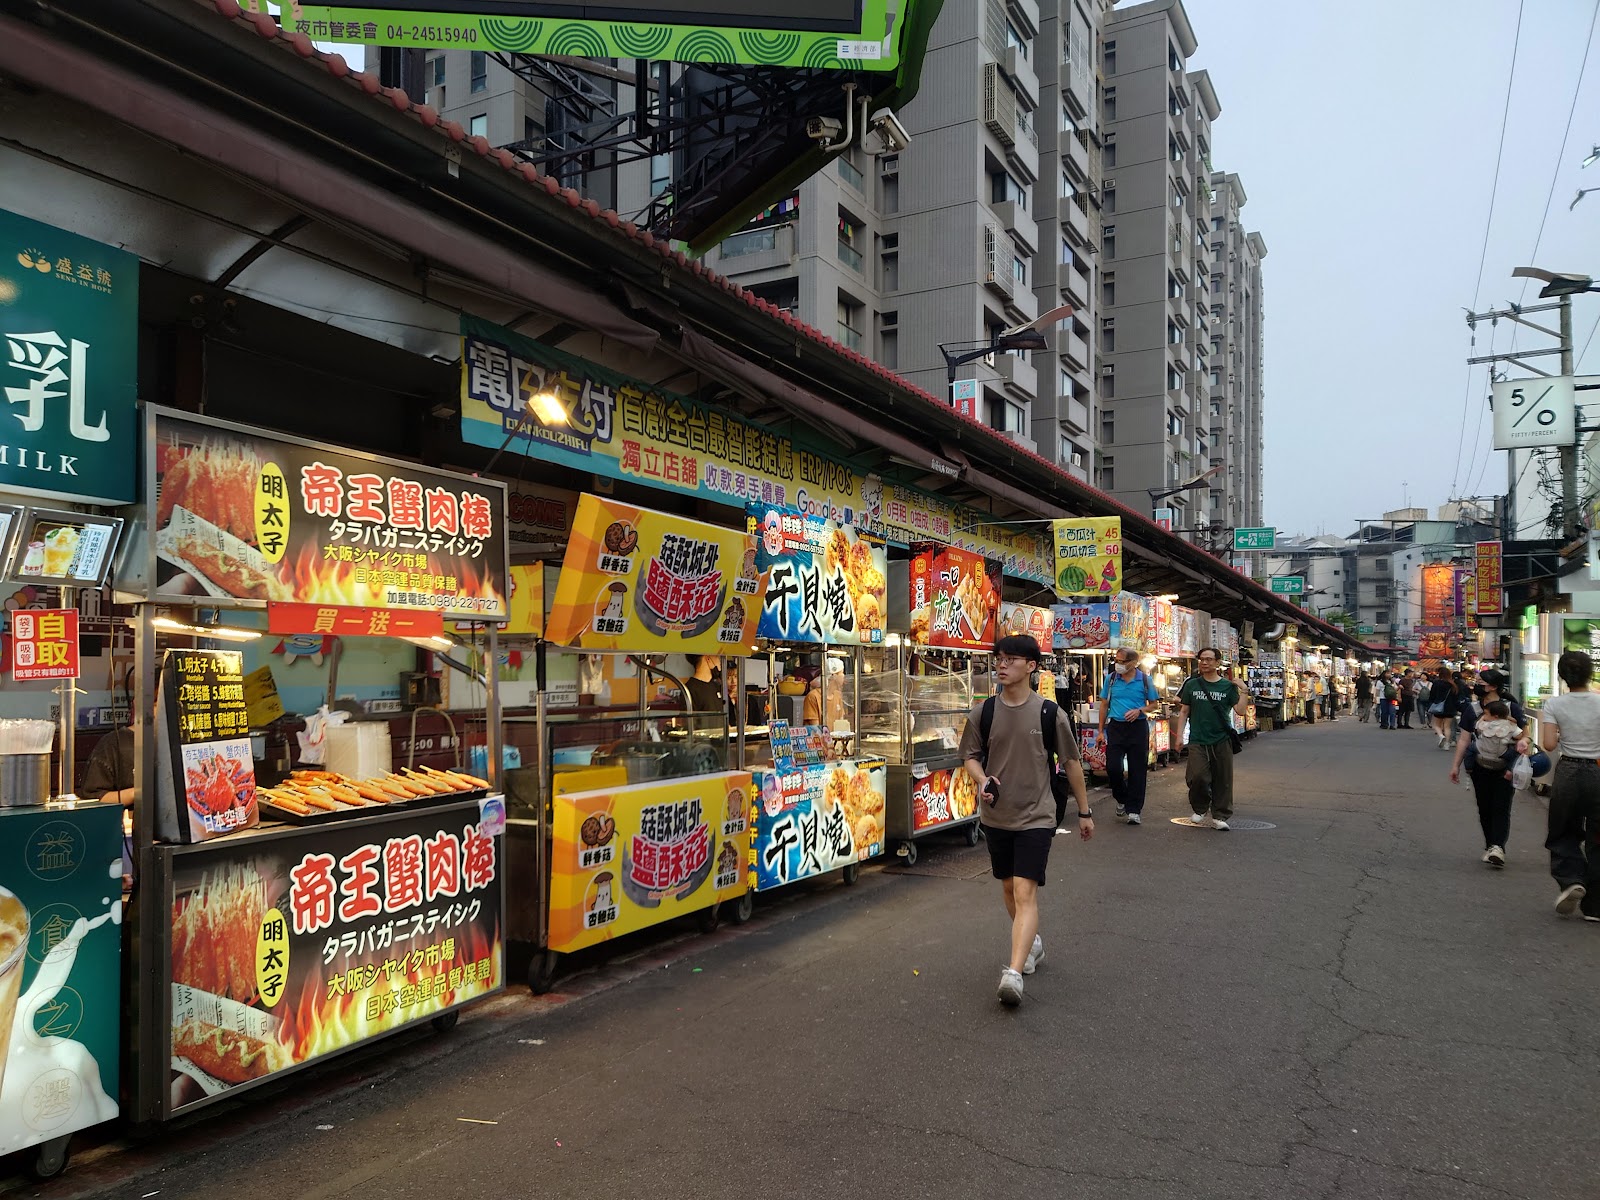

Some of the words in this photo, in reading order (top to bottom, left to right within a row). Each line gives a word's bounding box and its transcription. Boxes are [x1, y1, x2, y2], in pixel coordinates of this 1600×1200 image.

[387, 24, 477, 43] 04-24515940
[55, 272, 77, 284] SEND
[80, 279, 89, 287] IN
[91, 283, 112, 294] HOPE
[5, 331, 111, 443] 乳
[261, 473, 283, 555] 明太子
[300, 461, 493, 541] 帝王蟹肉棒
[1105, 528, 1118, 539] 45
[1105, 545, 1119, 555] 50
[601, 556, 629, 573] 鮮香菇
[354, 567, 457, 592] 日本空運品質保證
[312, 607, 415, 636] 買一送一
[36, 612, 69, 667] 自取
[20, 644, 31, 663] 吸管
[204, 806, 248, 833] 日本空運
[583, 848, 611, 866] 鮮香菇
[290, 822, 497, 936] 帝王蟹肉棒
[262, 918, 283, 998] 明太子
[365, 957, 492, 1021] 日本空運品質保證
